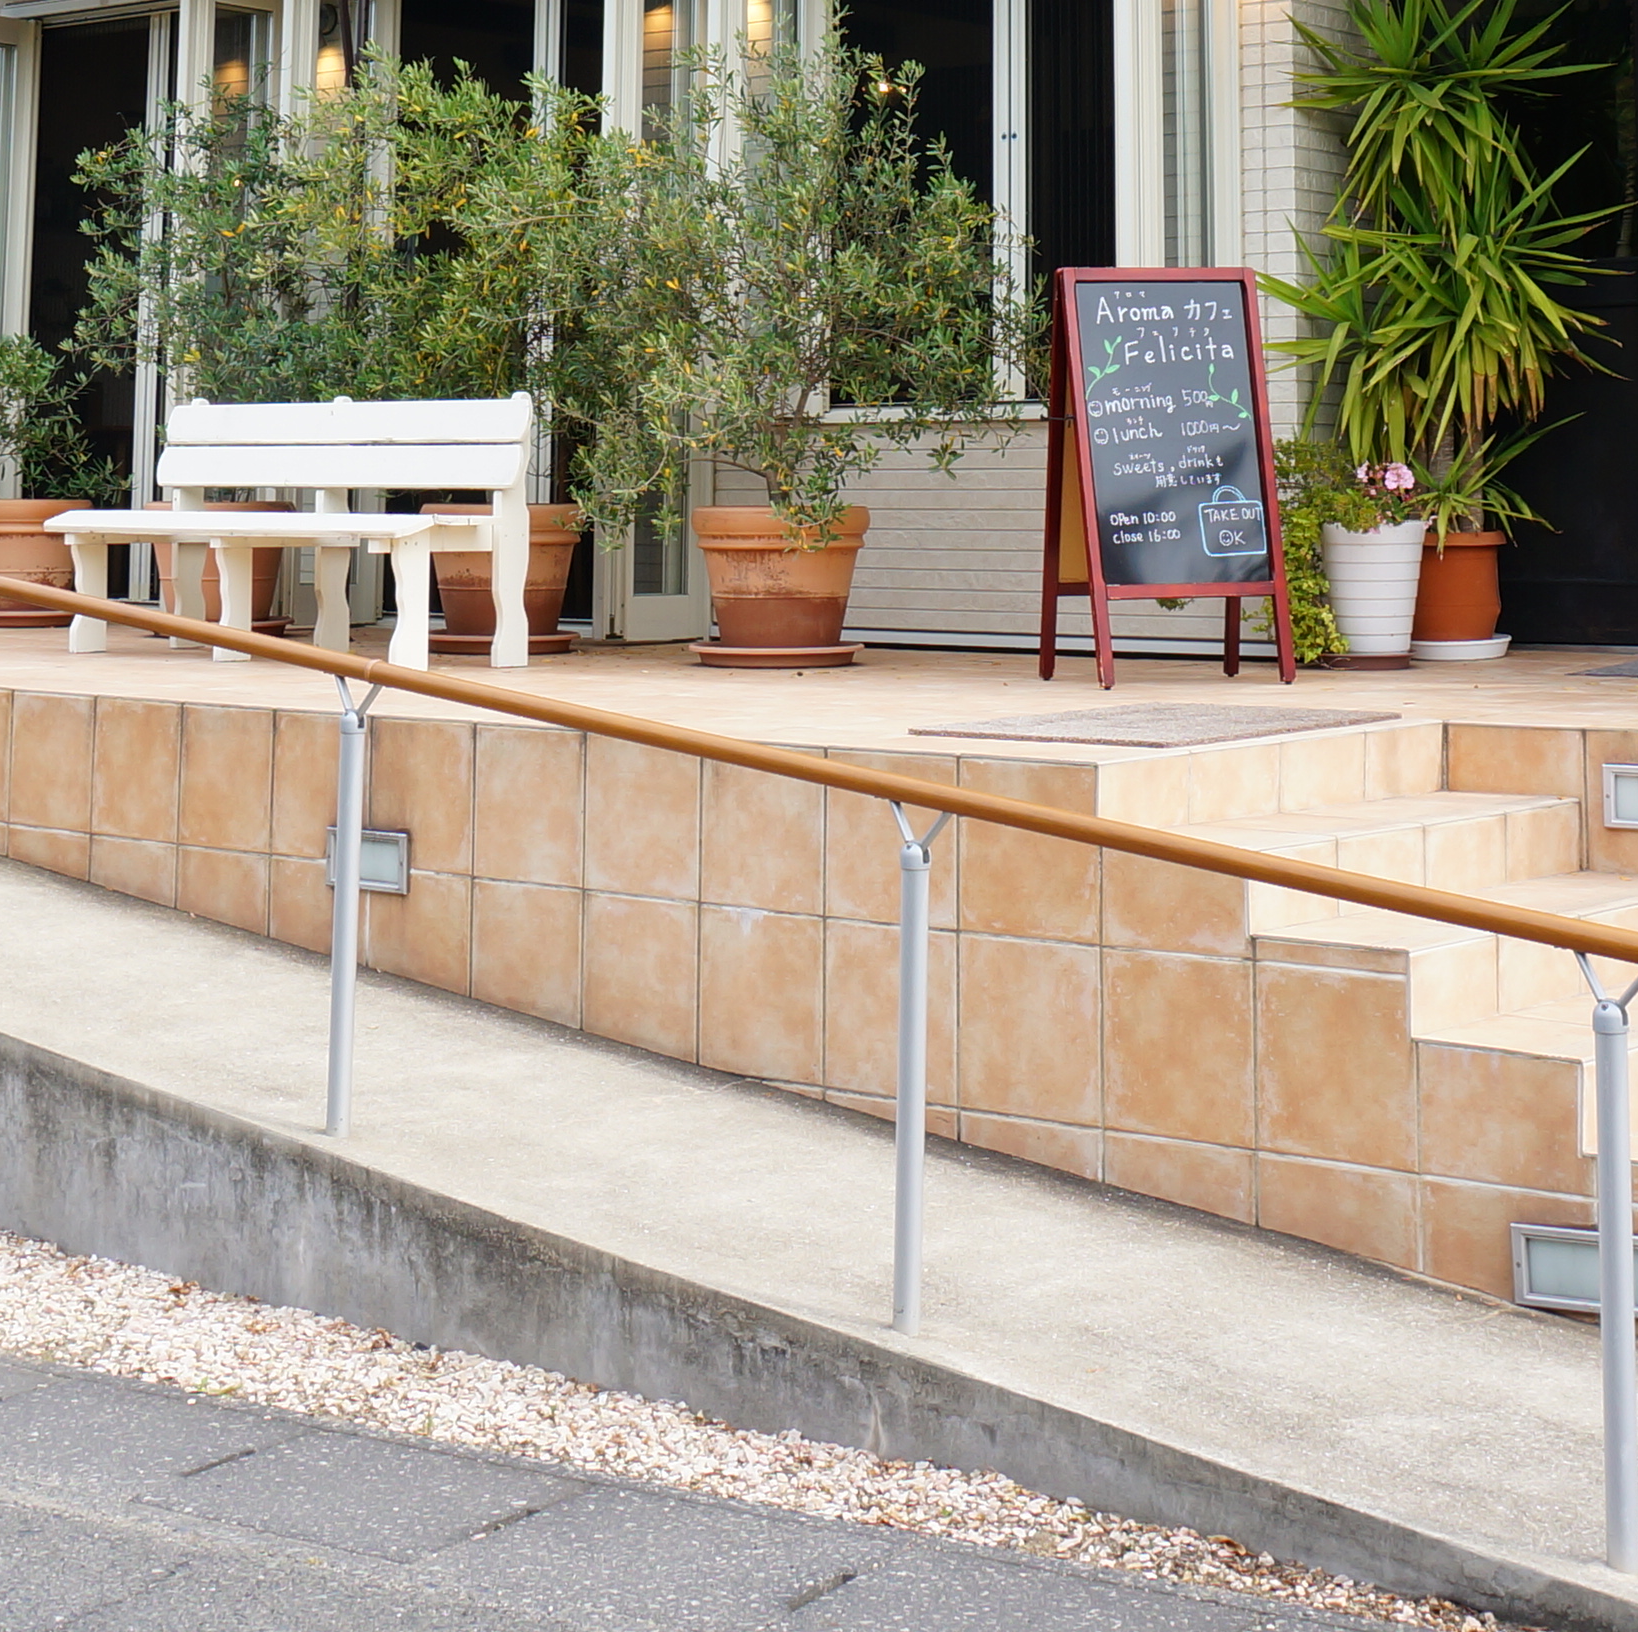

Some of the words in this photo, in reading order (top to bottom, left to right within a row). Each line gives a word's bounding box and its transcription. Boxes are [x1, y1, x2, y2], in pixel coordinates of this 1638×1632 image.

[1096, 296, 1175, 325] Aroma
[1183, 298, 1233, 321] カフェ
[1124, 335, 1235, 365] Felicita
[1104, 394, 1176, 415] morning
[1112, 422, 1164, 444] lunch
[1142, 511, 1177, 525] 10:00
[1203, 507, 1240, 523] TAKE
[1241, 506, 1263, 521] OUT
[1148, 528, 1182, 543] 16:00
